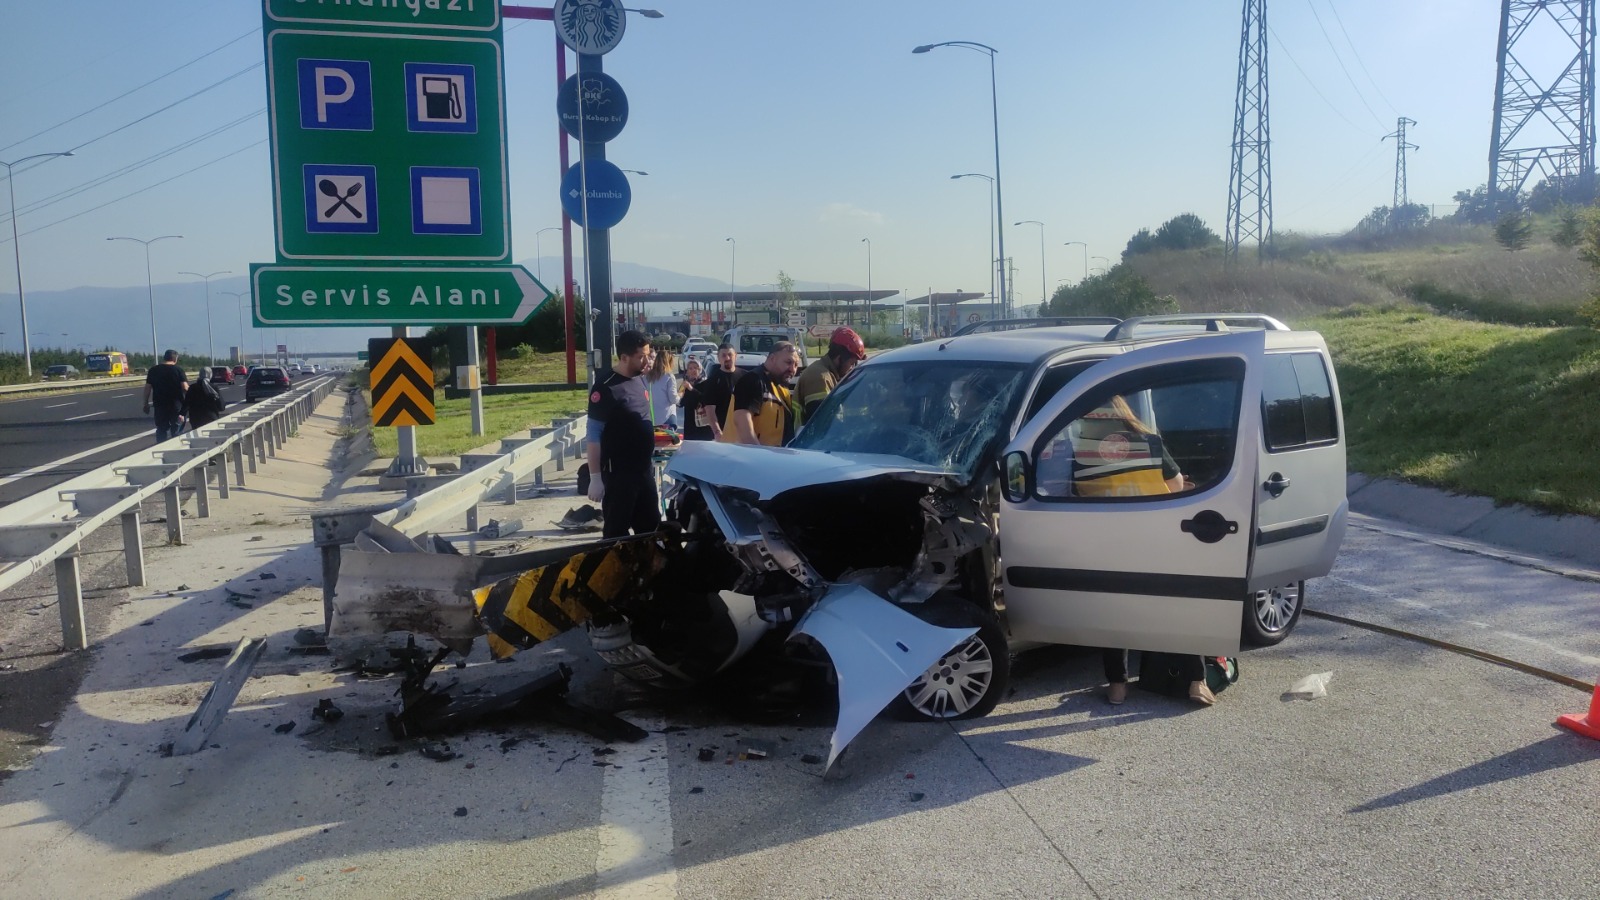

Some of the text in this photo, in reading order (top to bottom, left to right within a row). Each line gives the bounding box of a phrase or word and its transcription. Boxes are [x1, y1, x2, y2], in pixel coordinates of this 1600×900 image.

[315, 67, 355, 123] P
[276, 284, 500, 306] Servis Alanı
